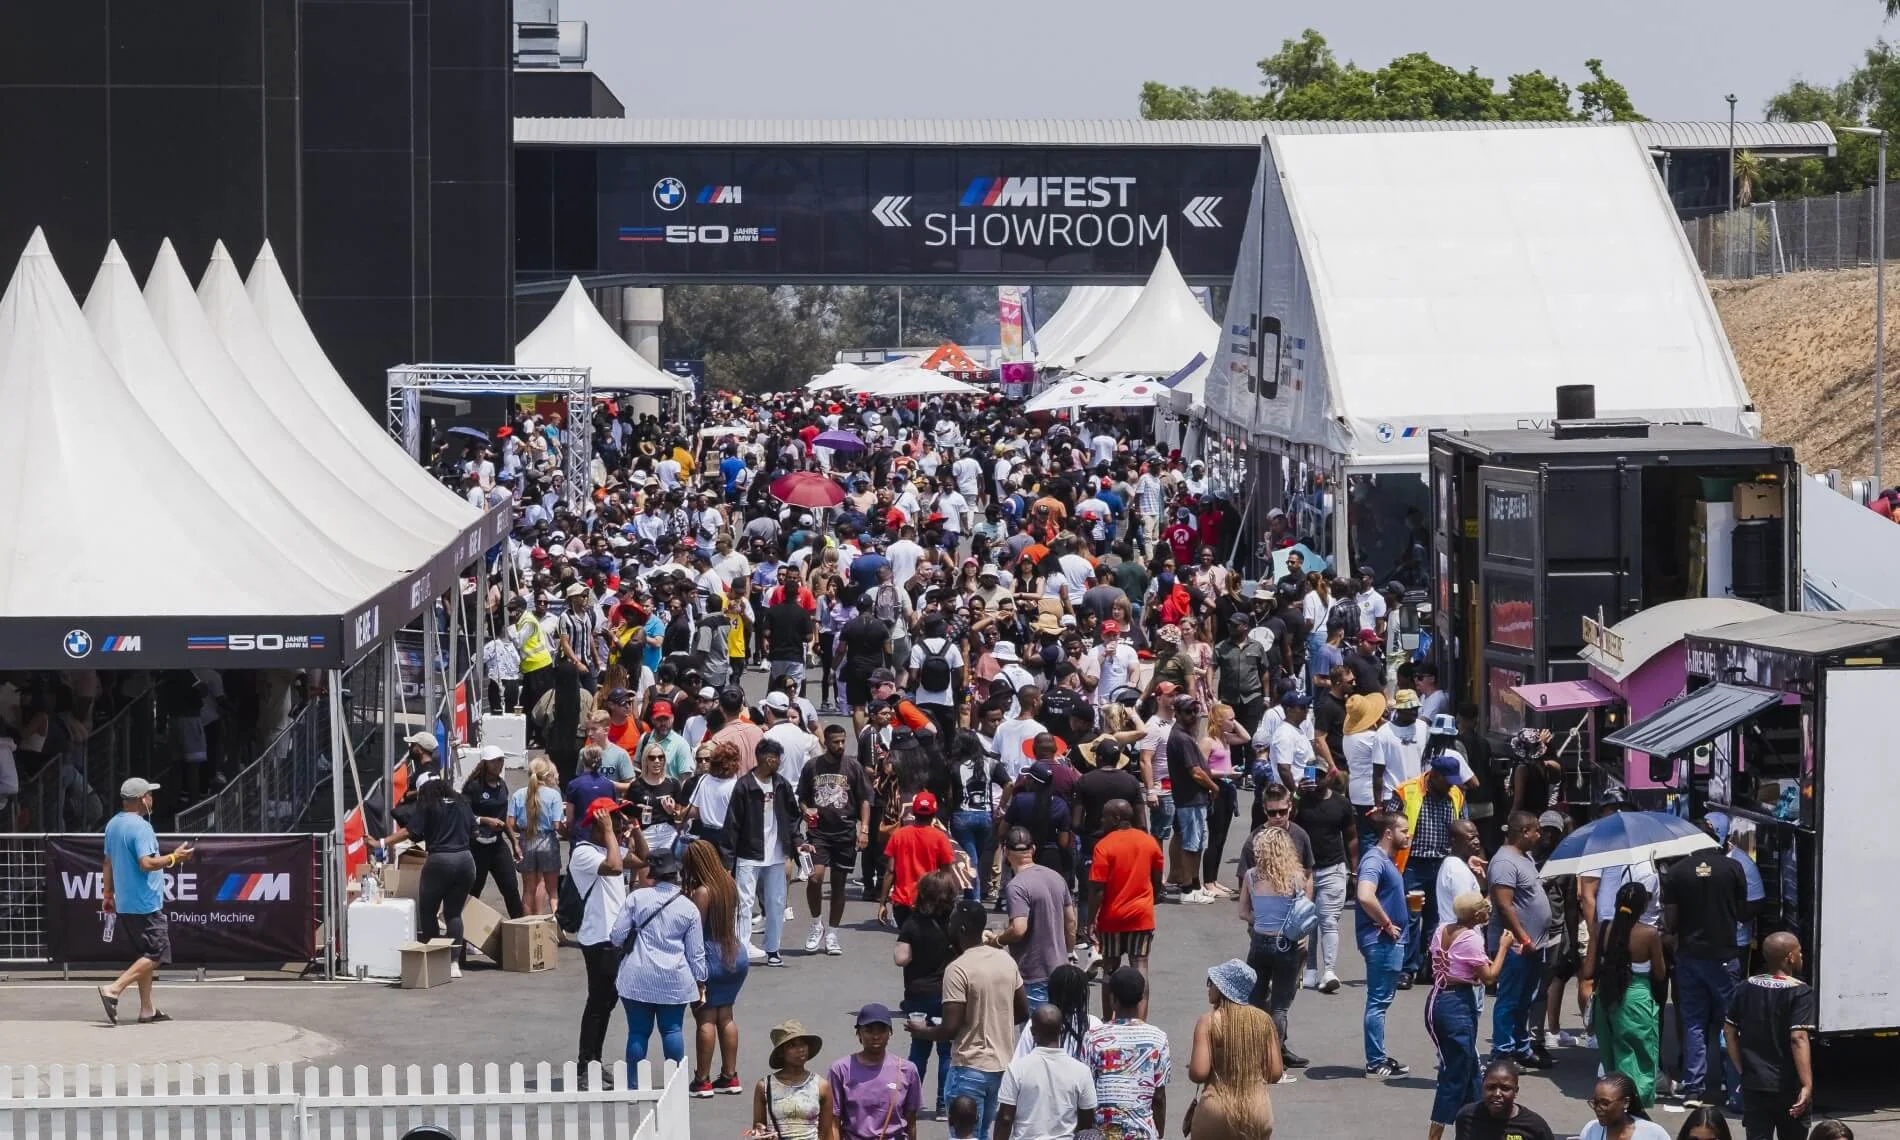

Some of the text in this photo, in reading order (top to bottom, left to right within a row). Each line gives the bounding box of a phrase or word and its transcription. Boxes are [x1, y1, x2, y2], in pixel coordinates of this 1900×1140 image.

[666, 225, 729, 243] 50
[733, 227, 759, 235] JAHRE
[924, 213, 1168, 247] SHOWROOM
[228, 634, 284, 650] 50
[161, 873, 199, 901] RE
[170, 911, 207, 923] Driving
[210, 911, 256, 922] Machine
